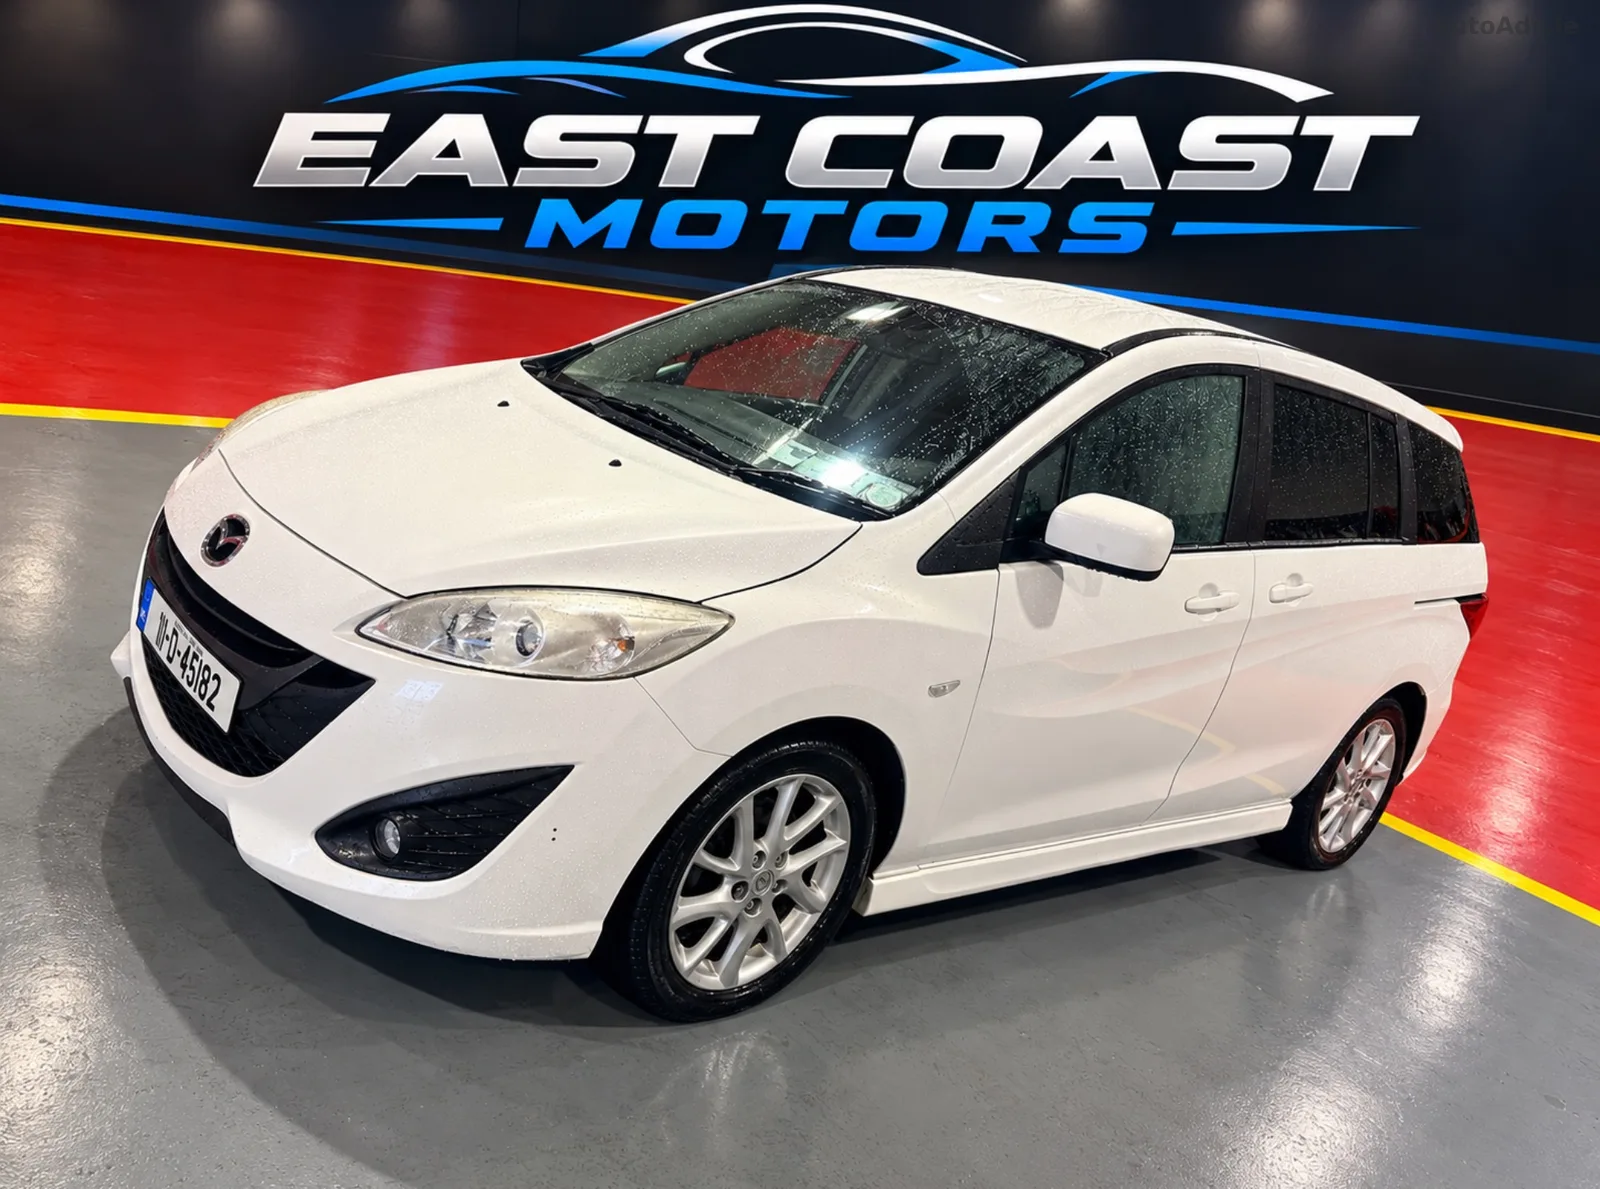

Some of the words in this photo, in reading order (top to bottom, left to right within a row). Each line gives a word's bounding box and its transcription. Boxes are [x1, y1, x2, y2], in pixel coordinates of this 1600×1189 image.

[253, 112, 761, 188] EAST
[785, 115, 1421, 191] COAST
[524, 199, 1156, 253] MOTORS
